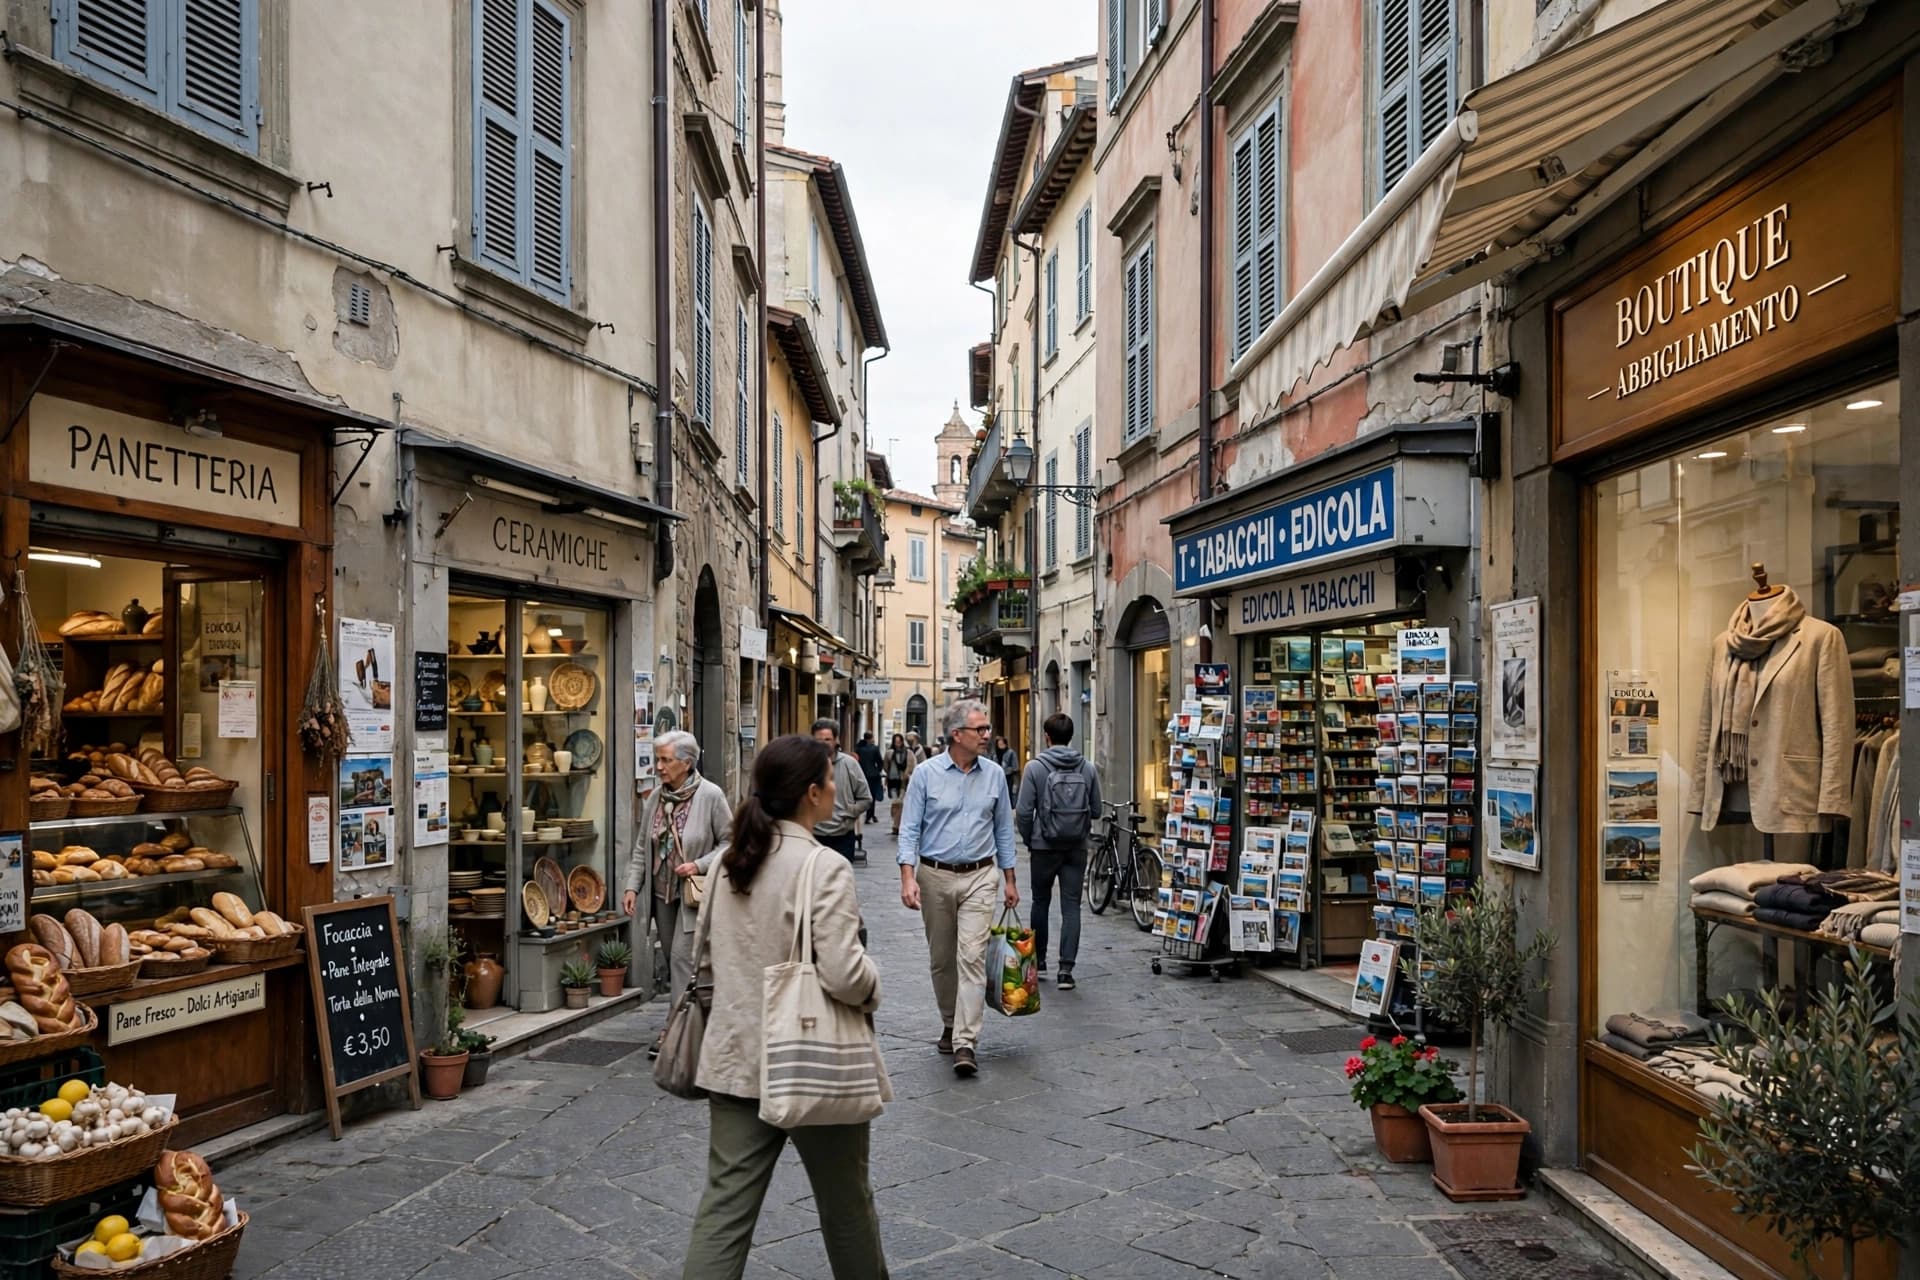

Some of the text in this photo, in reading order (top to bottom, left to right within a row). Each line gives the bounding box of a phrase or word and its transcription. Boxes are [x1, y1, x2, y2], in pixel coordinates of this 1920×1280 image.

[1615, 203, 1790, 348] BOUTIQUE
[1616, 284, 1799, 400] ABBIGLIAMENTO
[68, 425, 277, 504] PANETTERIA
[493, 516, 608, 571] CERAMICHE
[1179, 480, 1387, 582] T TABACCHI EDICOLA
[1242, 571, 1375, 625] EDICOLA TABACCHI
[323, 922, 373, 945] Focaccia
[328, 951, 390, 980] Pane Integrale
[116, 1012, 142, 1030] Pane
[145, 1007, 176, 1024] Fresco
[187, 995, 211, 1014] Dolci
[328, 995, 352, 1014] Torta
[353, 989, 374, 1007] della
[343, 1026, 390, 1057] €3,50
